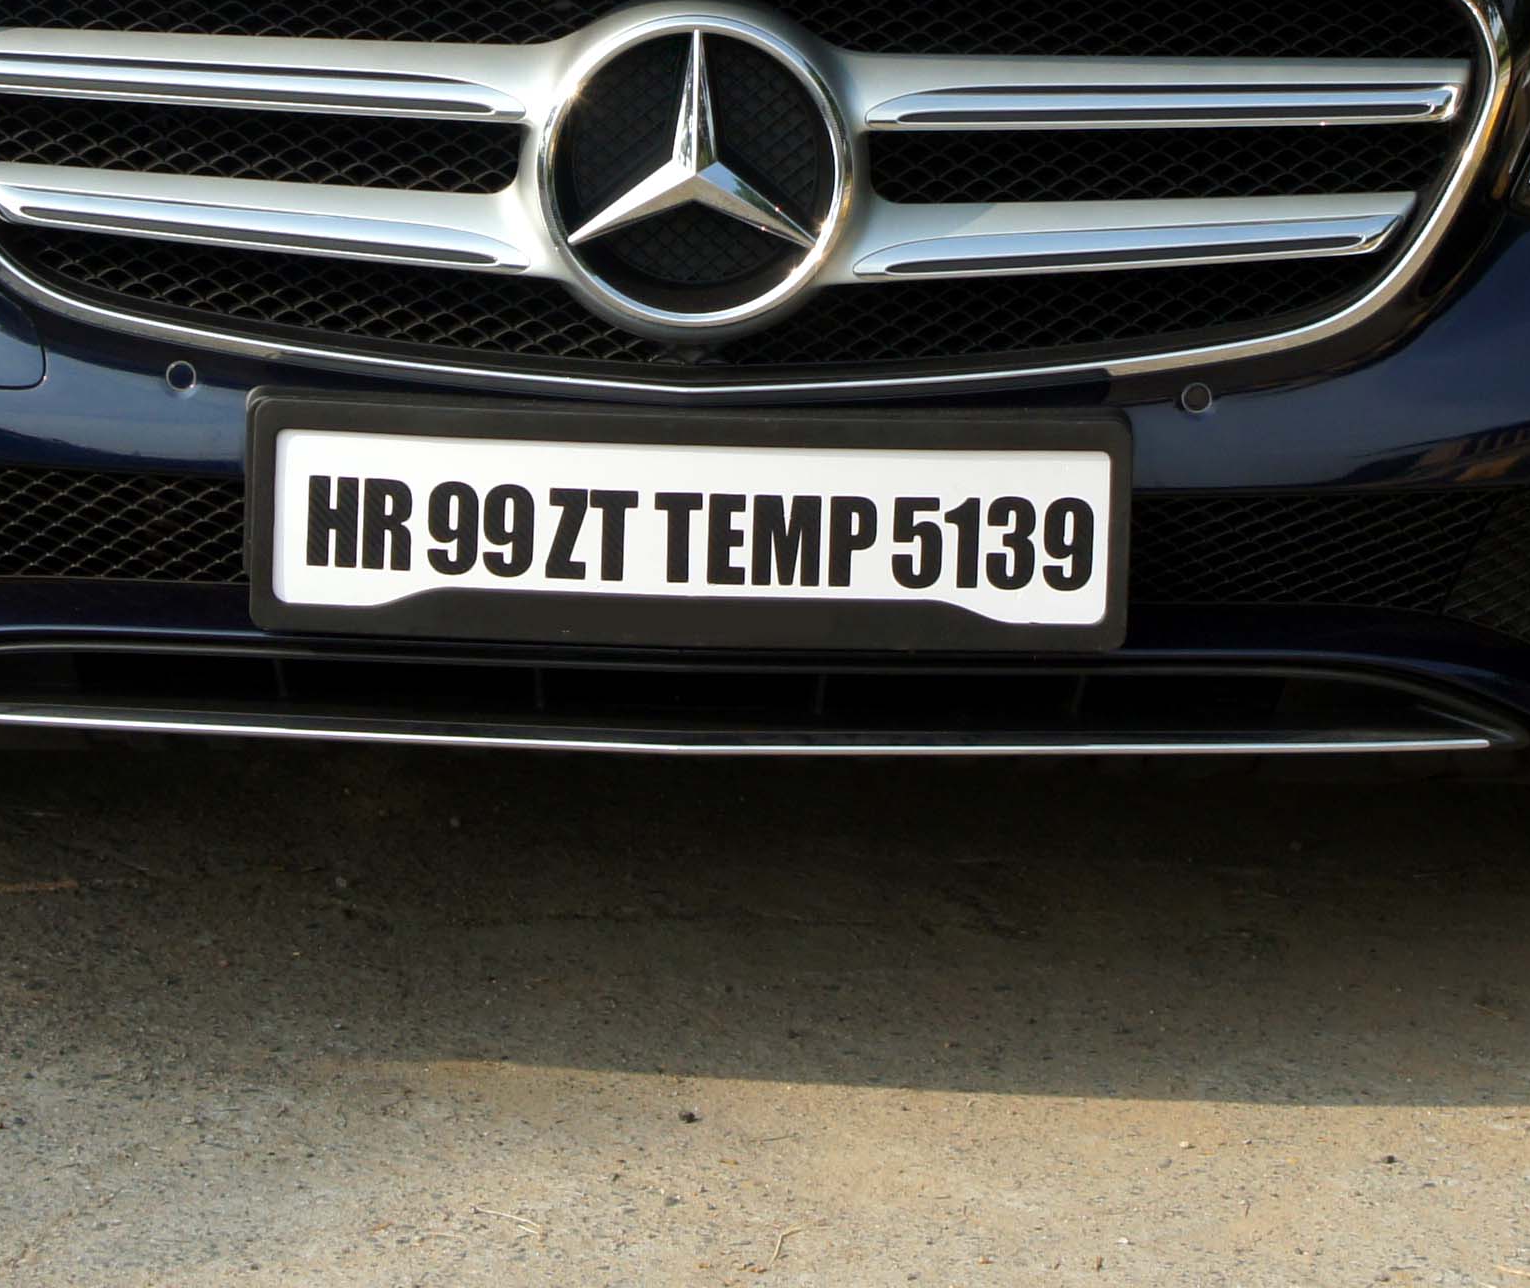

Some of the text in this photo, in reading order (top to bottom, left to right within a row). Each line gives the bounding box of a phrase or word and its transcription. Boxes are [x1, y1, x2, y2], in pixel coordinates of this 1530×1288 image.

[306, 475, 413, 571] HR
[655, 492, 877, 587] TEMP
[891, 496, 1095, 591] 5139
